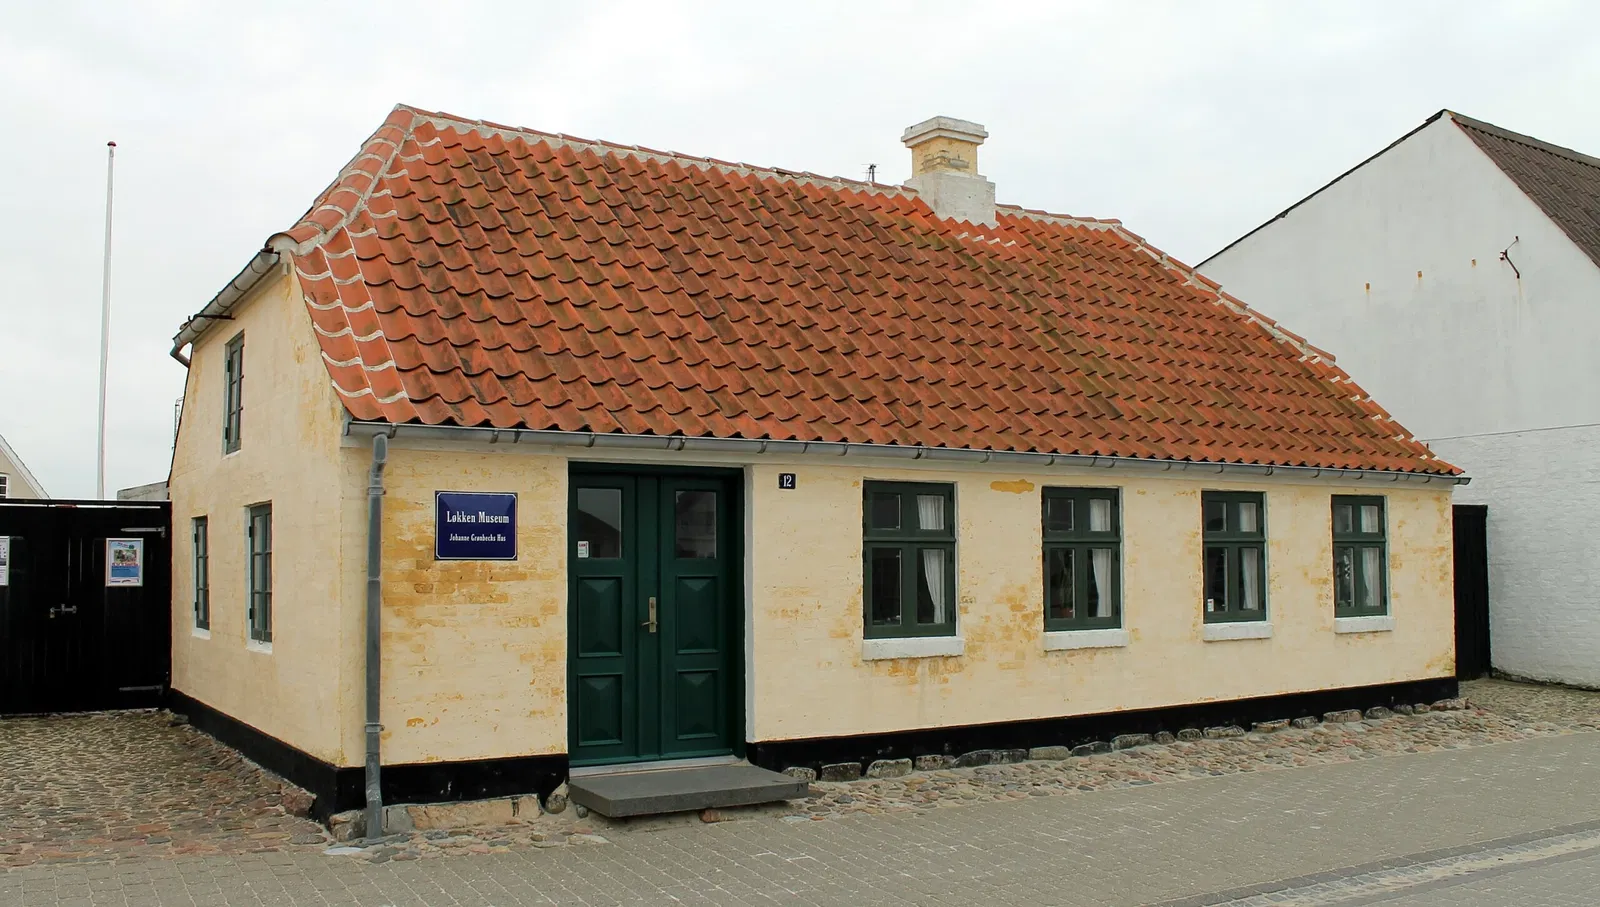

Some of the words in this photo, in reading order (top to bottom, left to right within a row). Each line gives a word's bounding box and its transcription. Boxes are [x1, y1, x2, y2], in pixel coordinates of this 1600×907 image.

[783, 474, 792, 487] 12
[446, 510, 476, 523] Løkken
[478, 511, 510, 524] Museum
[449, 533, 470, 542] Johanne
[496, 533, 506, 542] Hus
